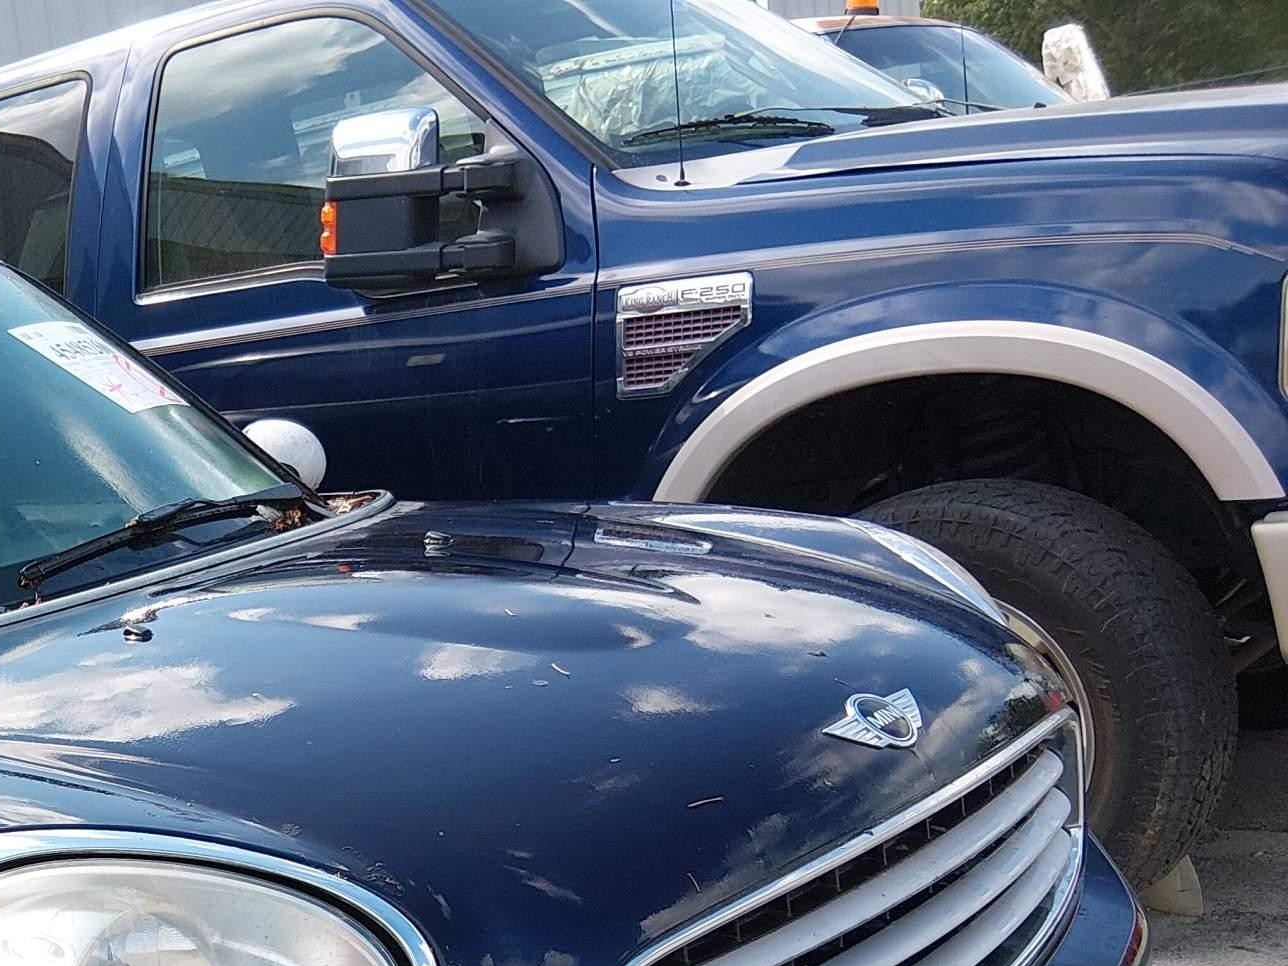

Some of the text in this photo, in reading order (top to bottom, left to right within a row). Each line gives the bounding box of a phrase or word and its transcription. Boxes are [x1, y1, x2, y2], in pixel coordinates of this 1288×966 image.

[623, 291, 673, 306] KING RANCH
[681, 282, 746, 299] F-250
[866, 704, 902, 728] MINI
